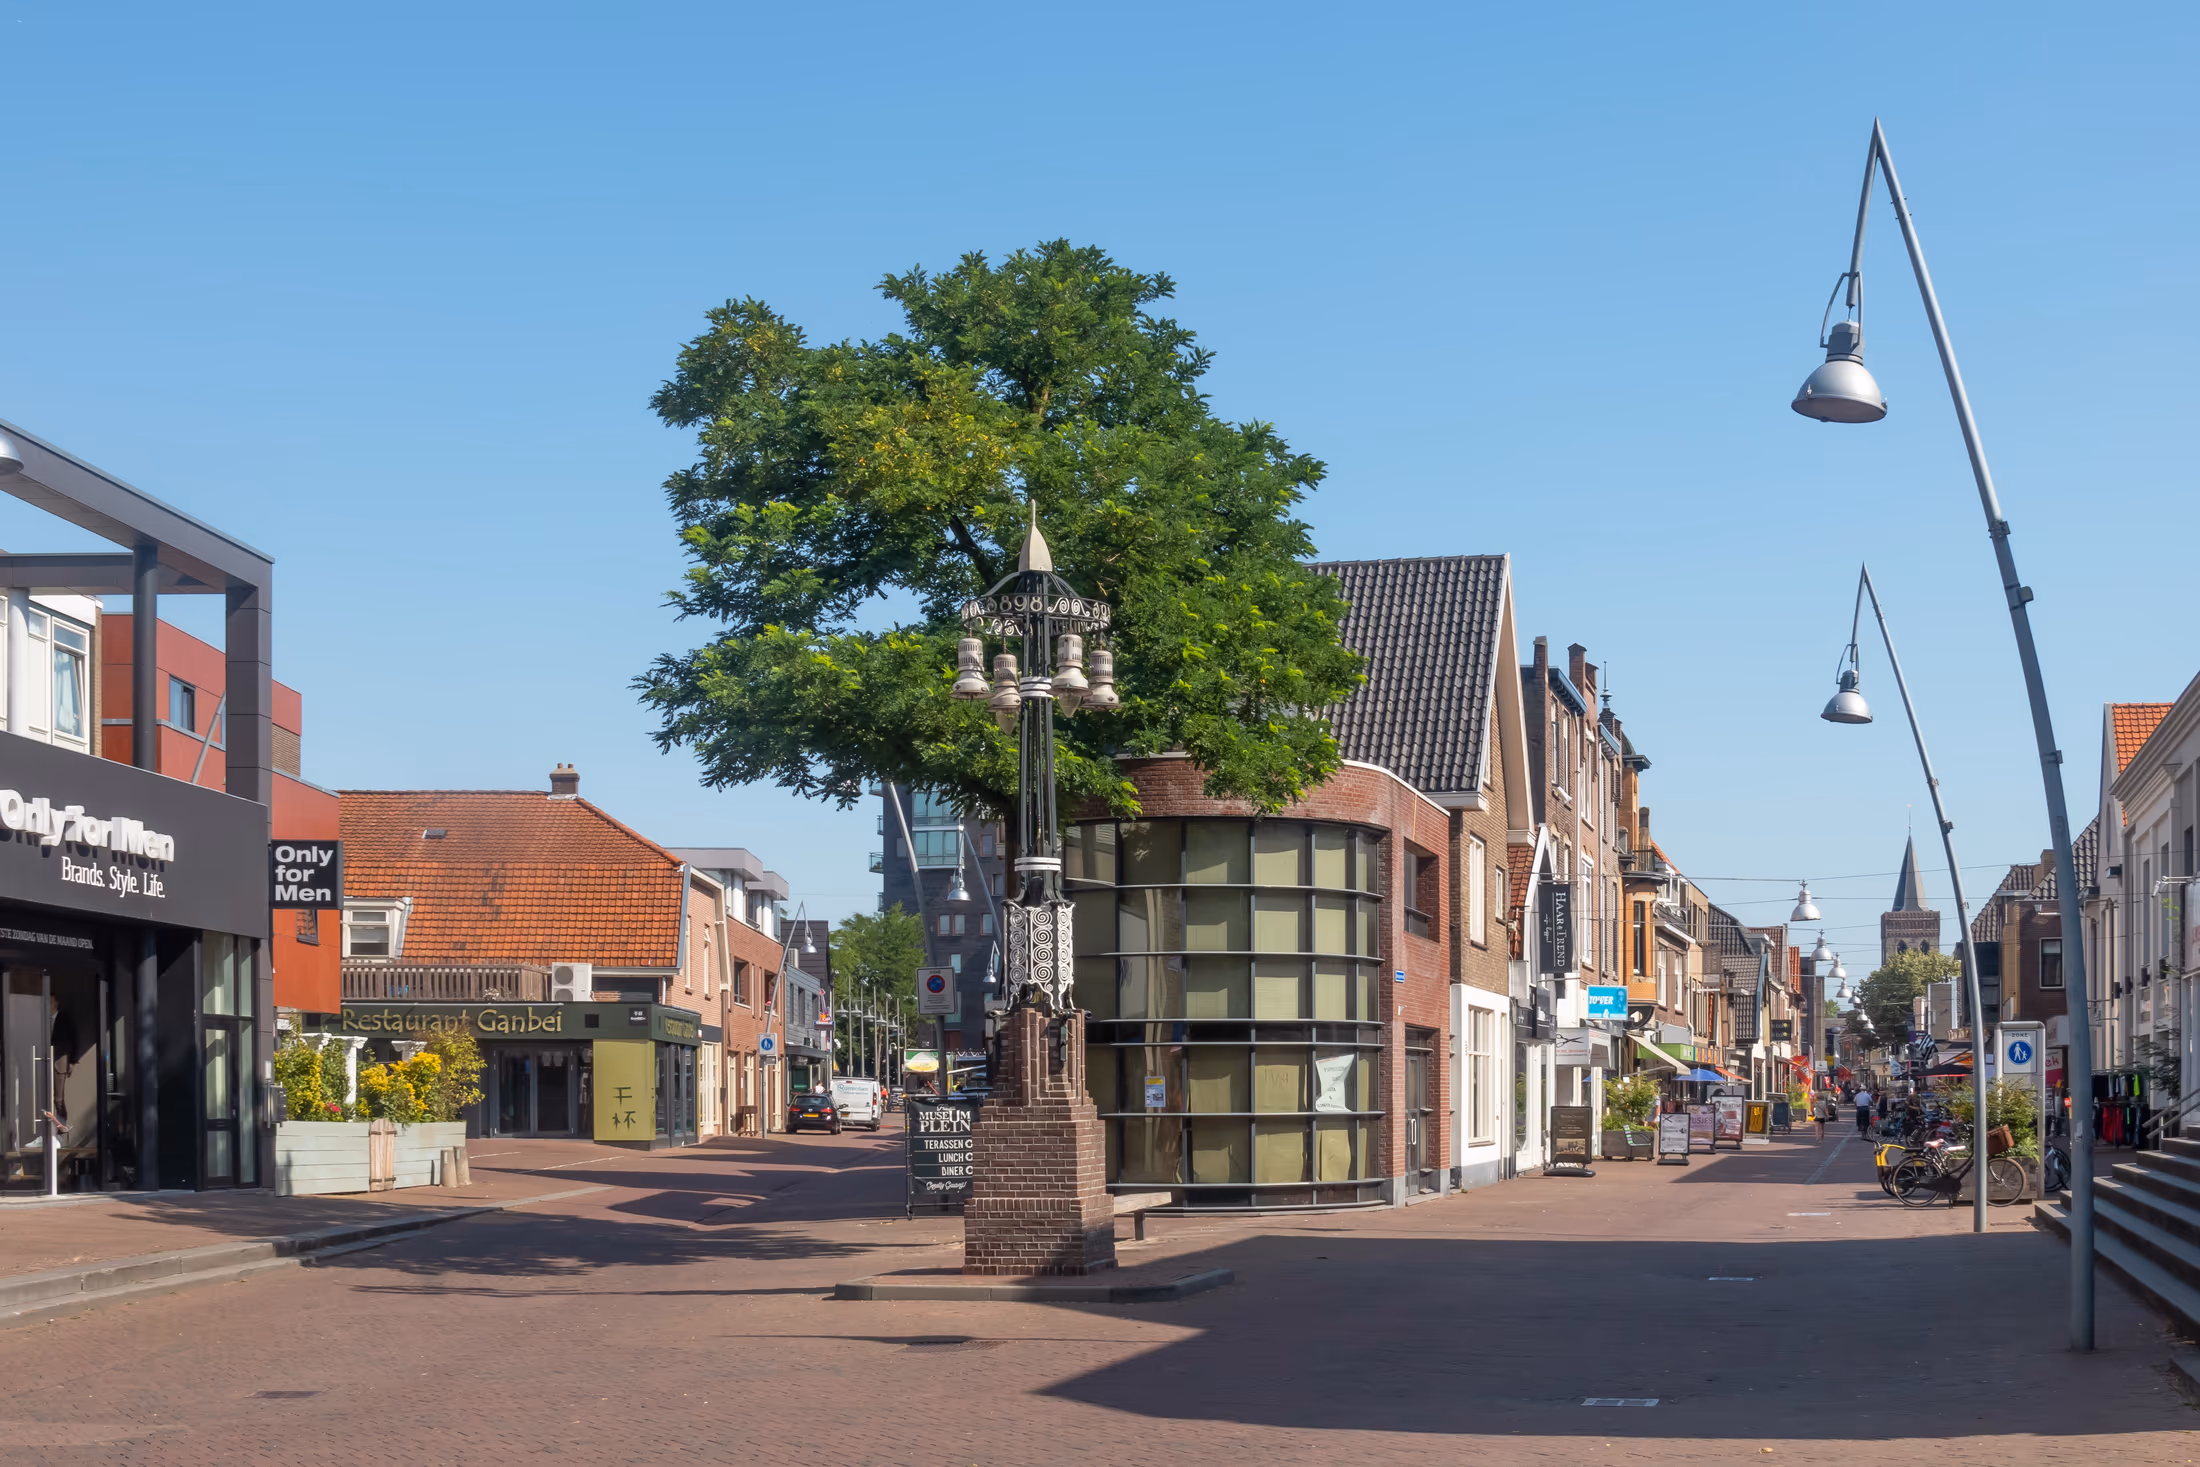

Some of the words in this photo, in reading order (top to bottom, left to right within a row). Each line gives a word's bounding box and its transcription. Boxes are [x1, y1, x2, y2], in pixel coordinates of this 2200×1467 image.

[0, 789, 66, 847] Only
[65, 805, 112, 847] for
[111, 817, 174, 862] Men
[275, 845, 334, 867] Only
[61, 856, 106, 887] Brands.
[109, 866, 140, 898] Style.
[143, 872, 166, 898] Life.
[275, 864, 315, 882] for
[275, 884, 331, 901] Men
[1555, 892, 1567, 925] HAAR
[1556, 930, 1568, 967] TREND
[342, 1008, 471, 1033] Restaurant
[477, 1006, 562, 1034] Ganbei
[919, 1109, 972, 1123] MUSEUM
[919, 1119, 972, 1133] PLEIN
[924, 1139, 964, 1150] TERASSEN
[938, 1152, 964, 1163] LUNCH
[941, 1166, 964, 1176] DINER
